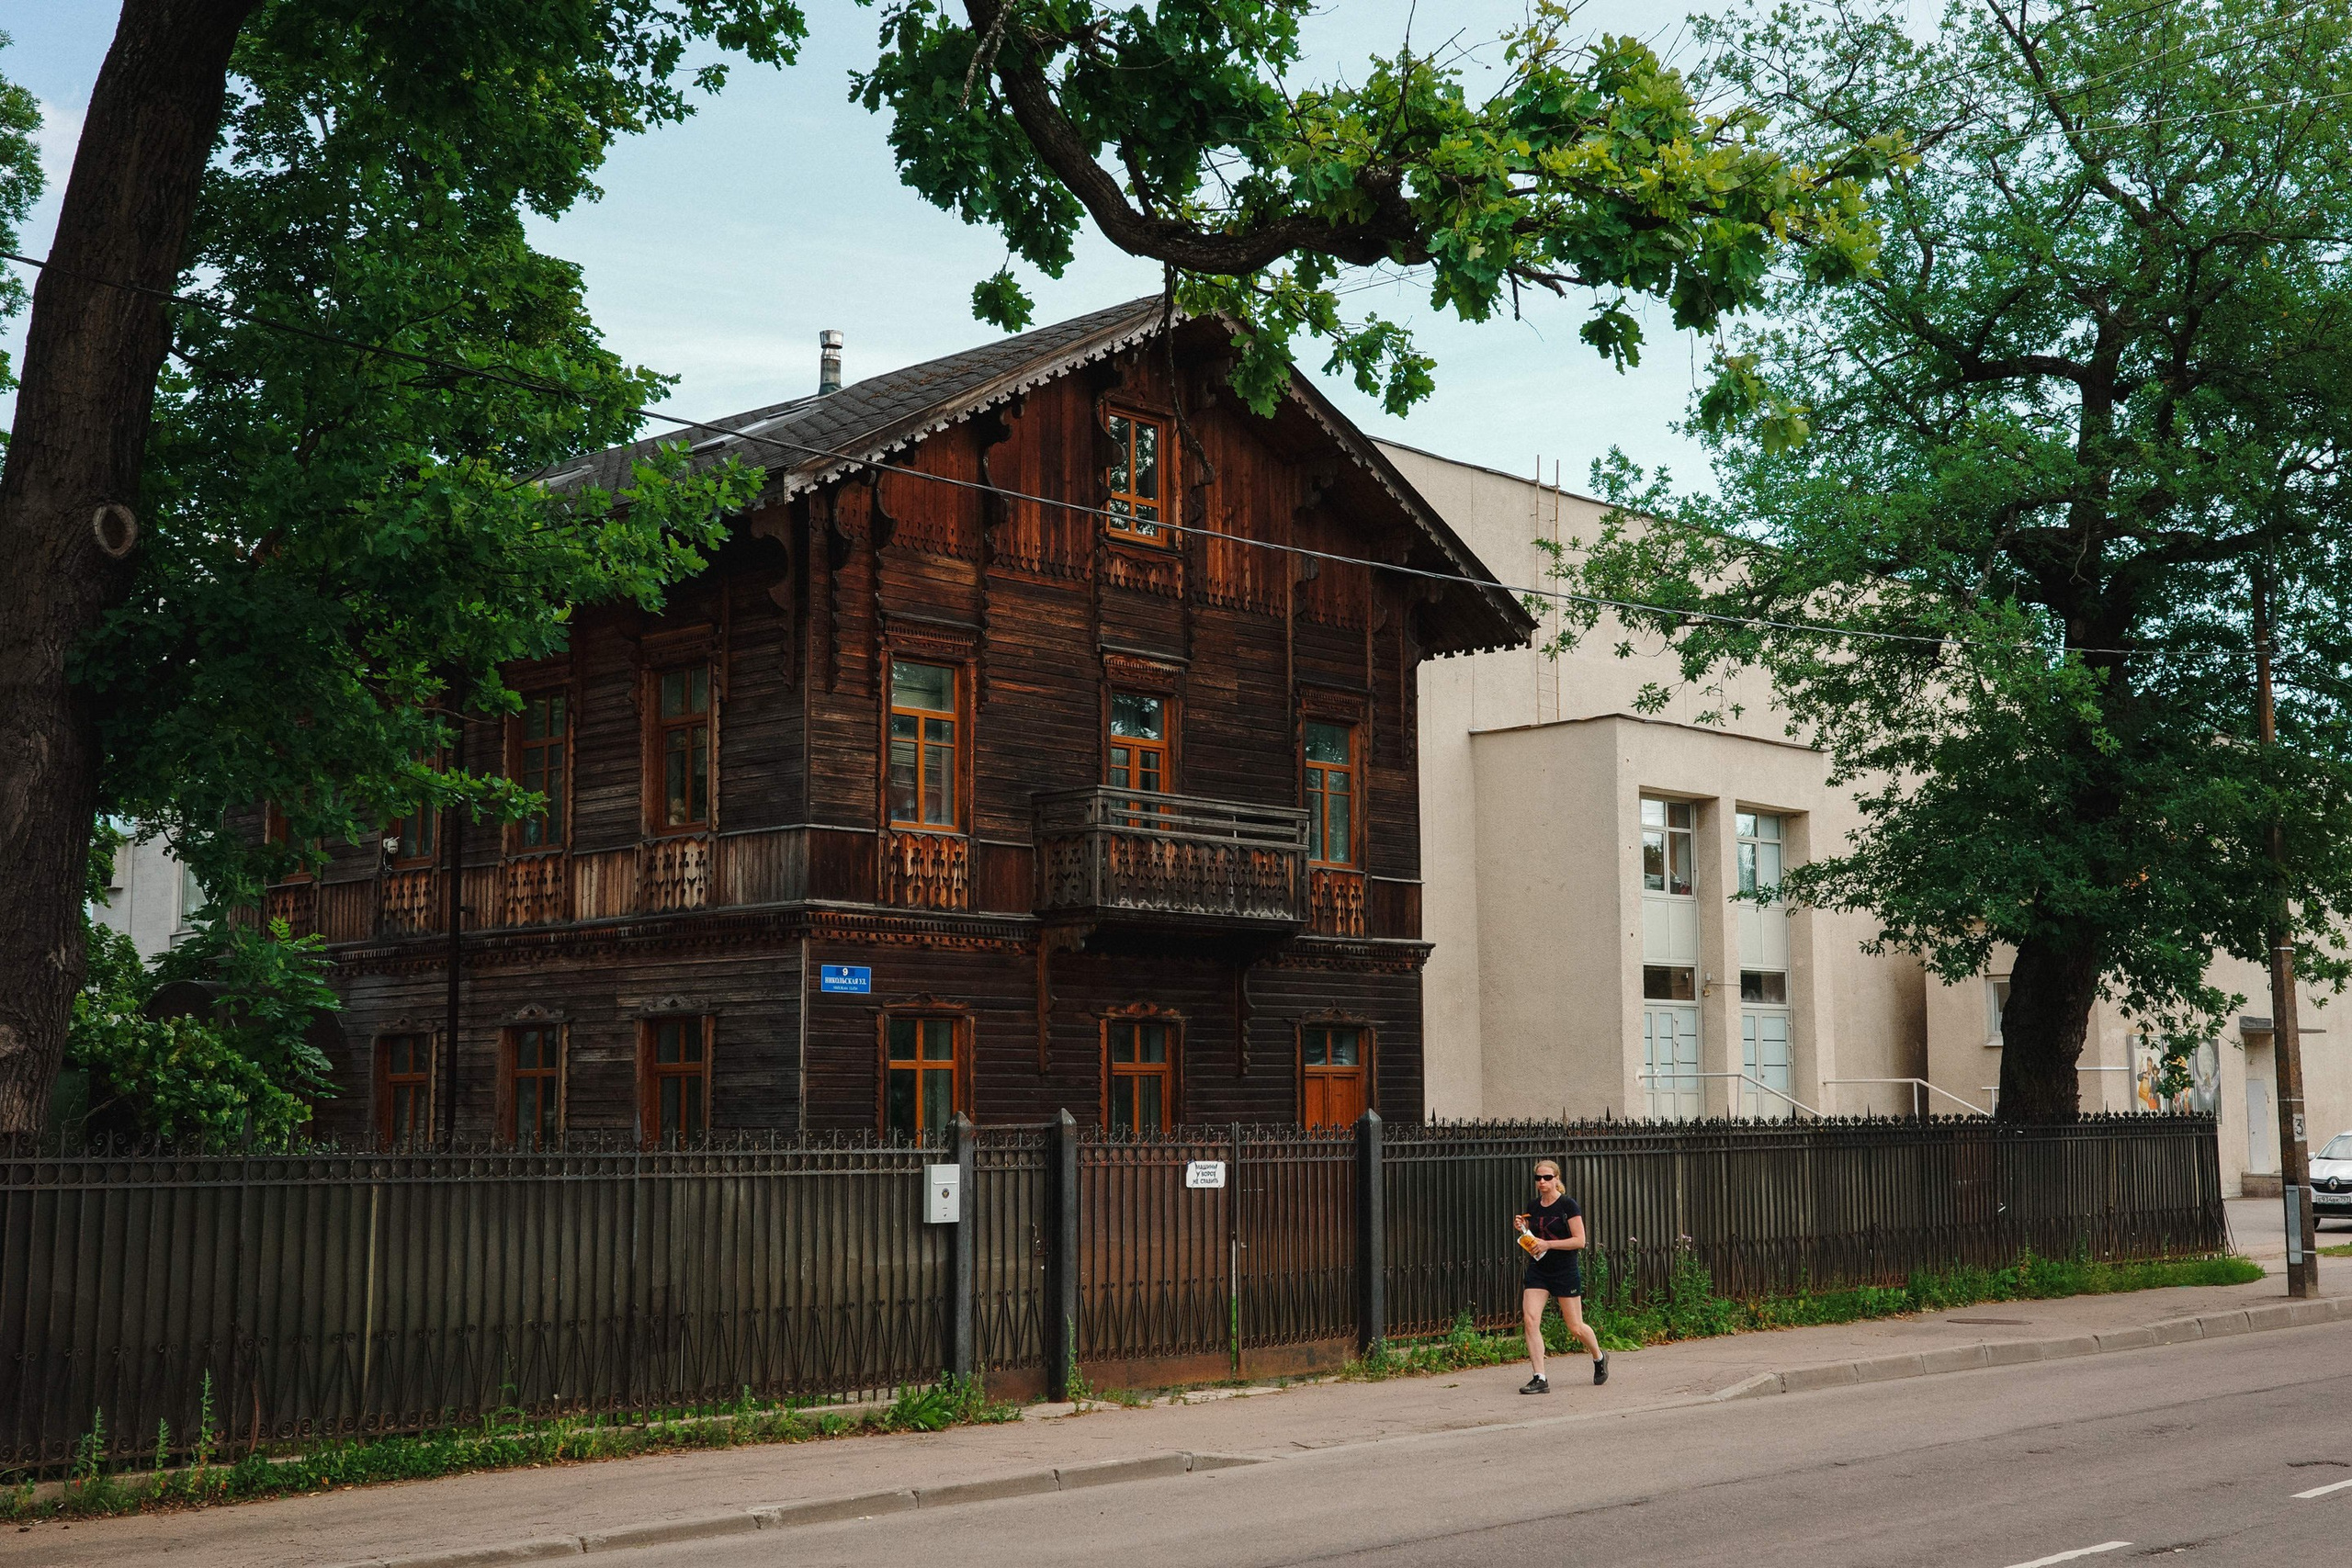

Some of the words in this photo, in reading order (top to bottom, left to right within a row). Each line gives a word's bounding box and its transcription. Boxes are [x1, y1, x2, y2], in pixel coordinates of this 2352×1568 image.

[842, 967, 849, 976] 9
[824, 976, 858, 985] НИКОЛЬСКАЯ
[2295, 1118, 2304, 1135] 3
